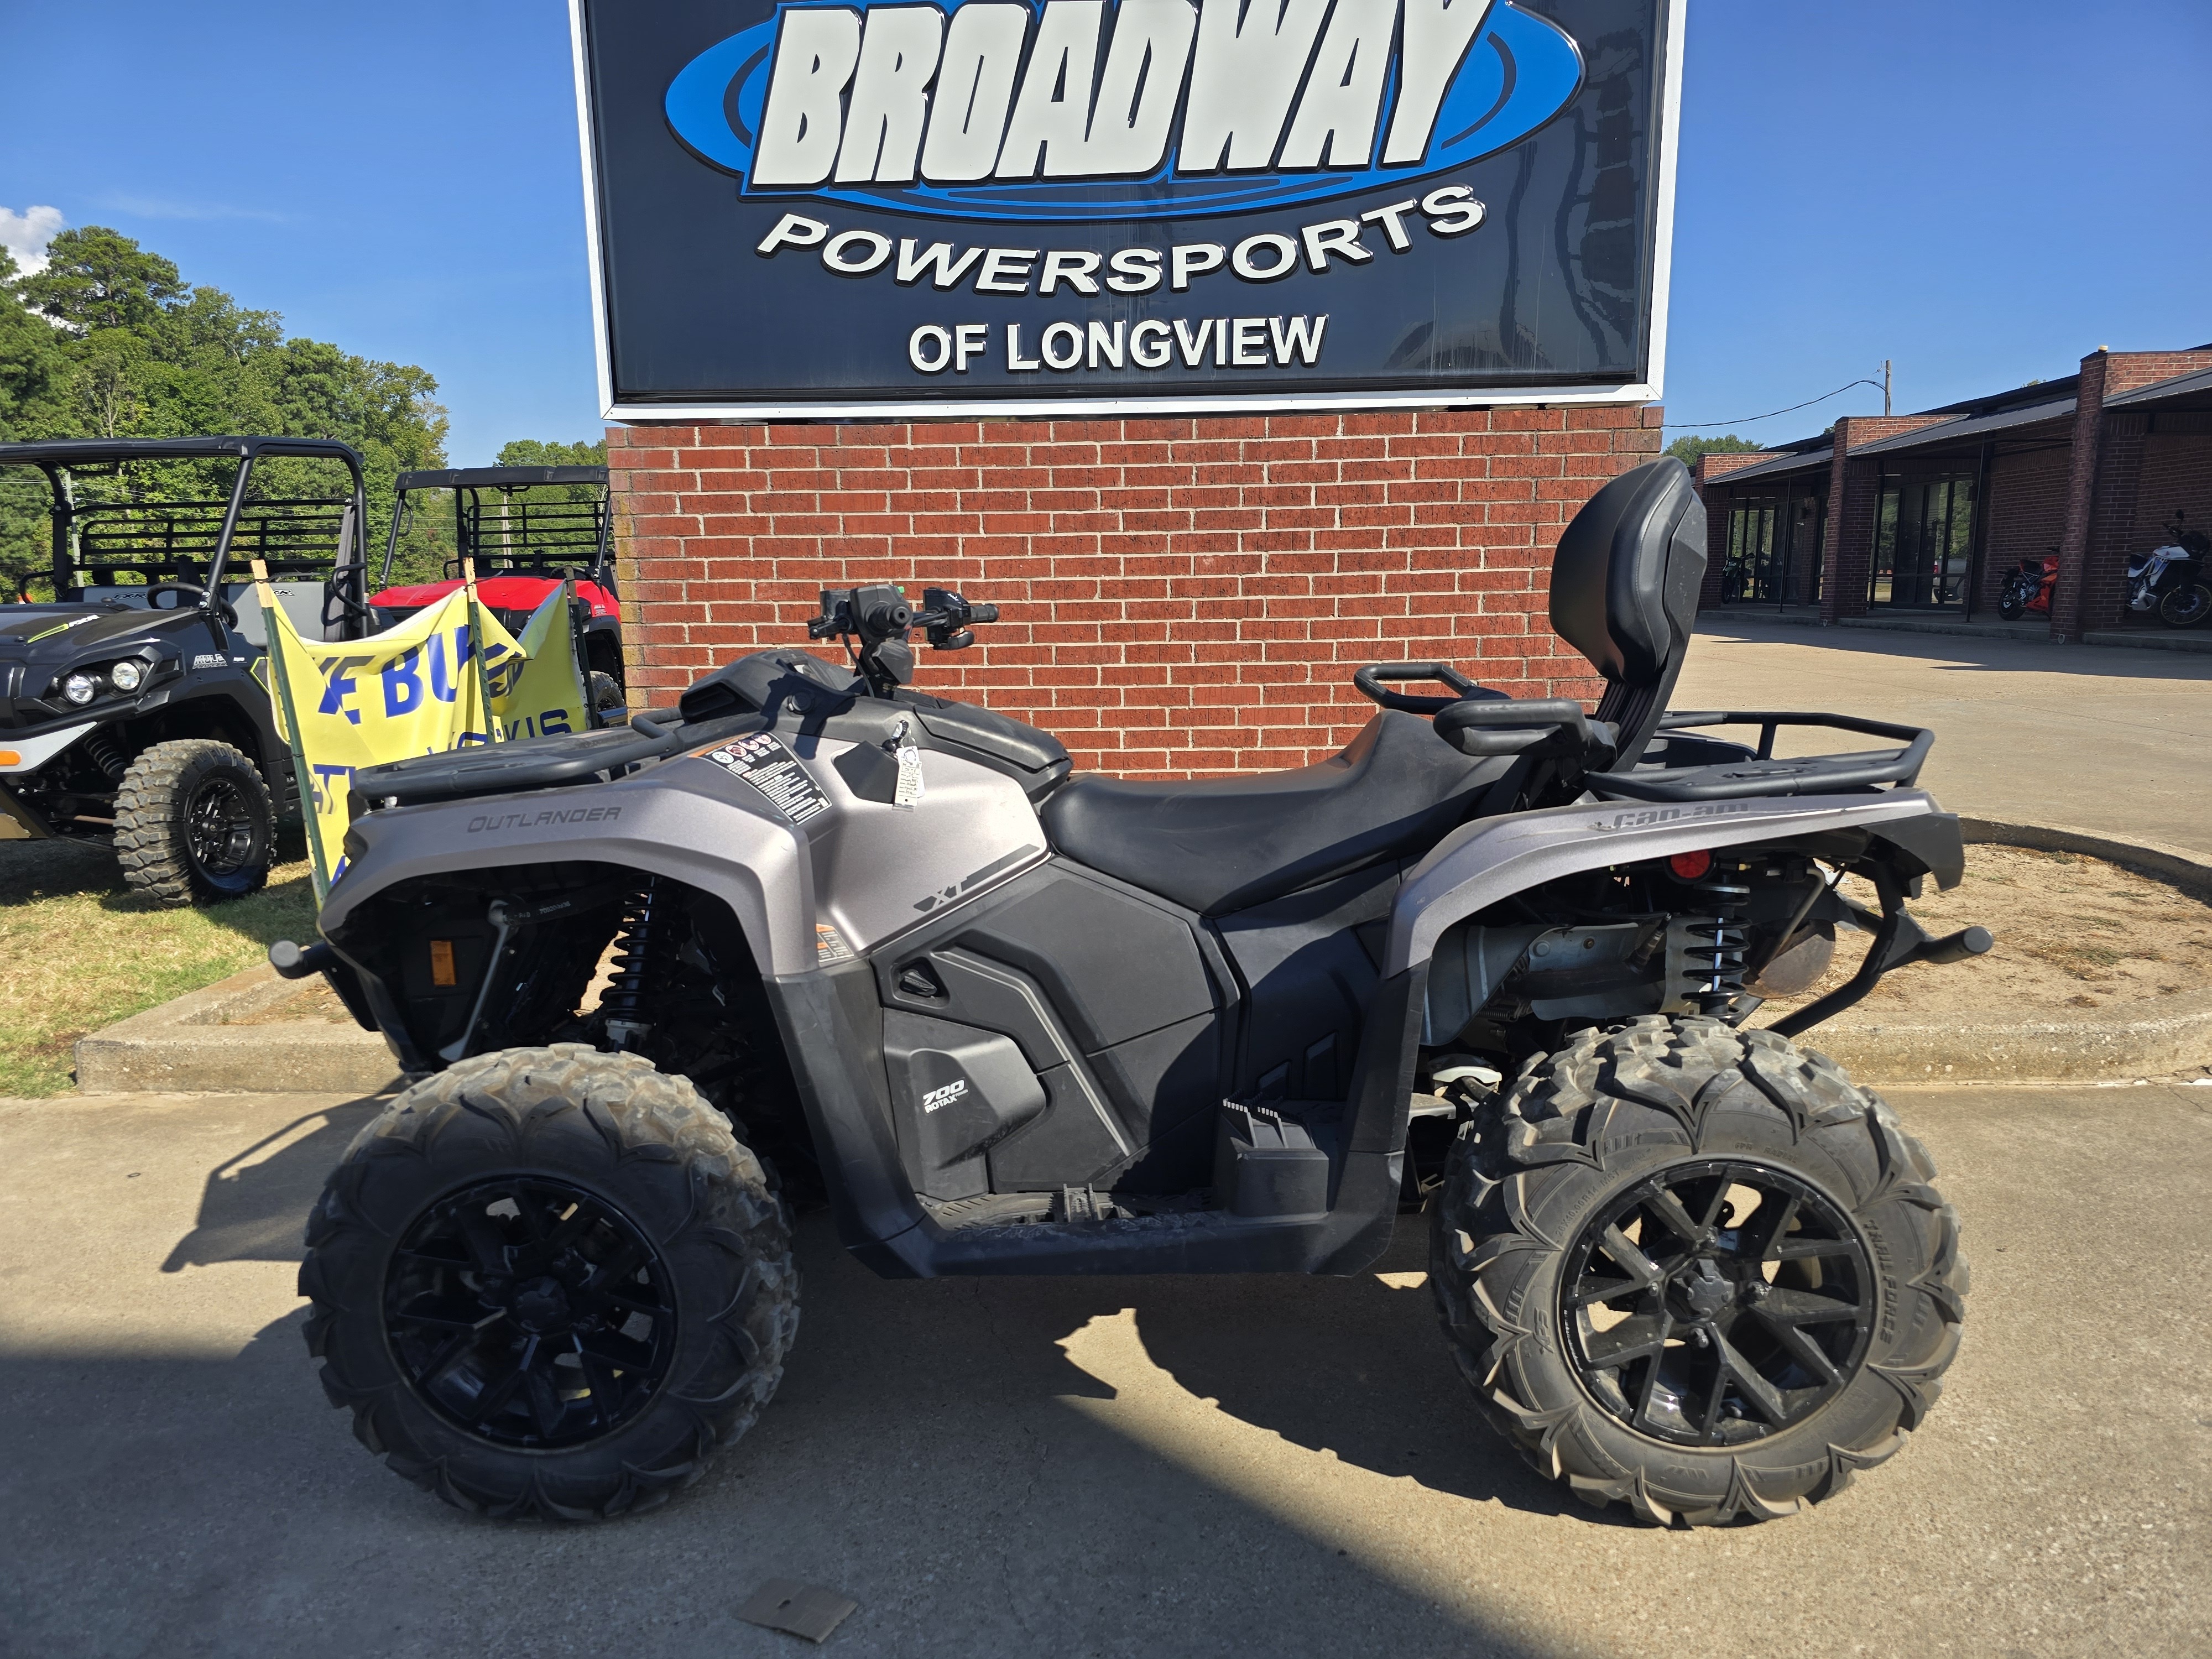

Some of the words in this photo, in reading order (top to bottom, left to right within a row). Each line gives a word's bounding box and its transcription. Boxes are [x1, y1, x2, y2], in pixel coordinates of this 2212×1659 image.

[753, 0, 1493, 184] BROADWAY
[757, 186, 1484, 294] POWERSPORTS
[910, 324, 988, 371] OF
[1008, 316, 1328, 370] LONGVIEW
[194, 654, 227, 665] MULE
[467, 807, 622, 833] OUTLANDER
[931, 877, 968, 910] XT
[923, 1079, 964, 1105] 700
[925, 1094, 957, 1113] ROTAX
[1863, 1219, 1895, 1271] TRAIL
[1880, 1275, 1898, 1344] FORCE
